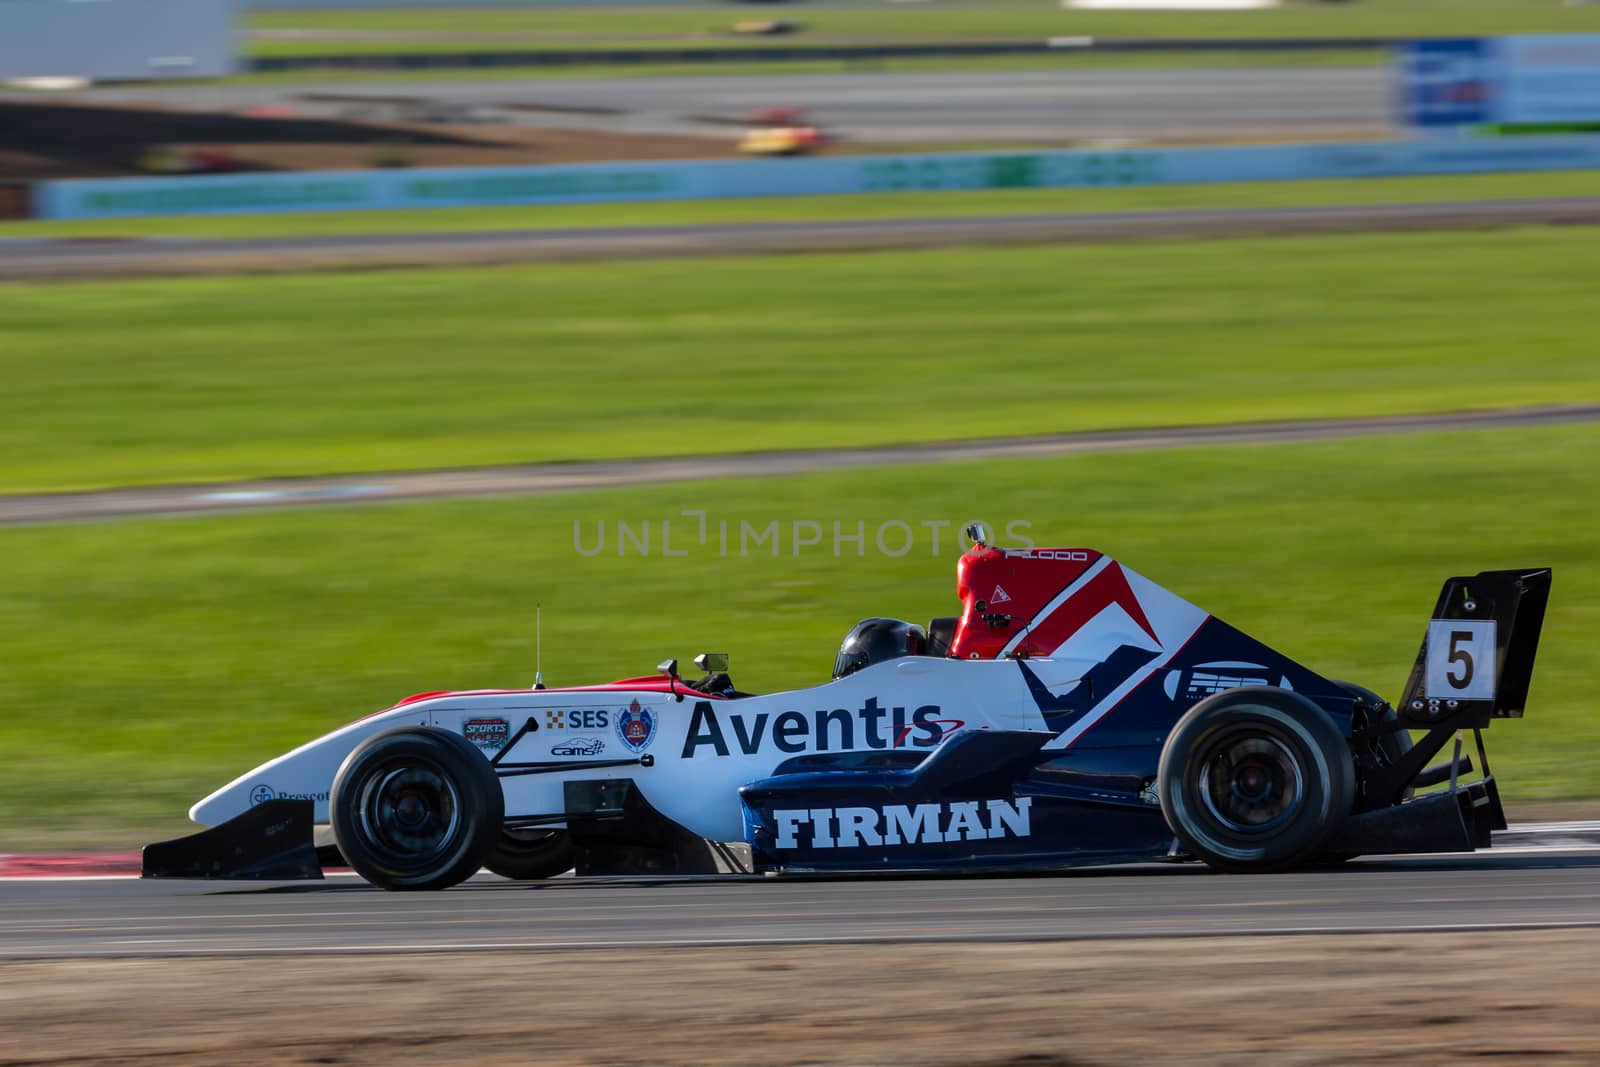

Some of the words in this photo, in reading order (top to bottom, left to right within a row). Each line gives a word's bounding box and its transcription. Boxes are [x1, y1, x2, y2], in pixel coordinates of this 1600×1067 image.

[1446, 631, 1474, 690] 5
[466, 724, 507, 733] SPORTS
[569, 710, 609, 728] SES
[680, 696, 945, 759] Aventis
[551, 747, 595, 756] cams
[773, 796, 1033, 849] FIRMAN
